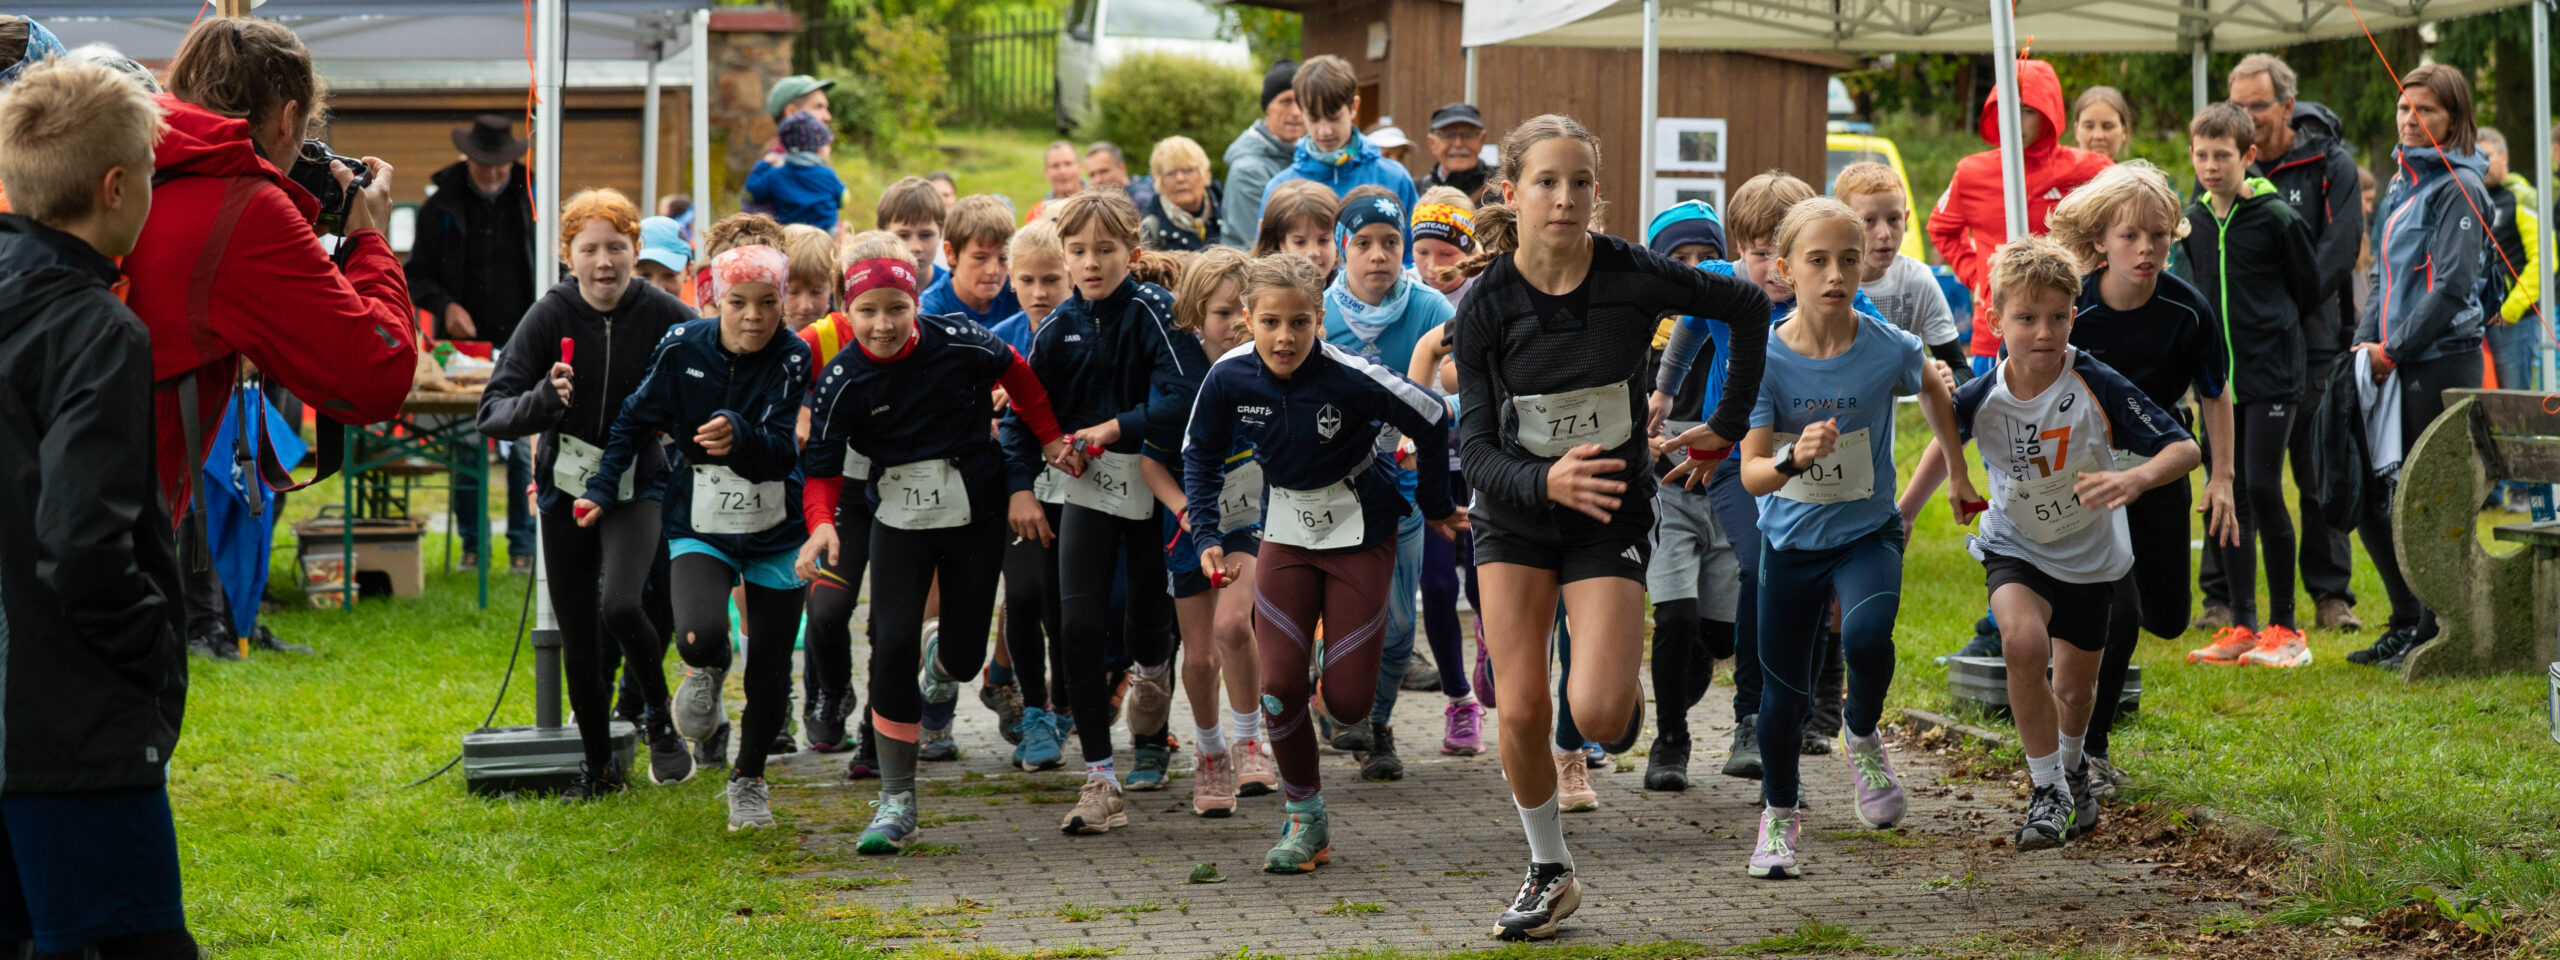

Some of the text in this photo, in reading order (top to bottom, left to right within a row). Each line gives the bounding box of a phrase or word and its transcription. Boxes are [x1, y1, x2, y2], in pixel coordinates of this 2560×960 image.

[1064, 334, 1081, 342] JAKO
[686, 367, 704, 378] JAKO
[1237, 405, 1265, 415] CRAFT
[1794, 397, 1857, 409] POWER
[1547, 411, 1599, 437] 77-1
[2014, 437, 2029, 469] LAUF
[1093, 470, 1127, 496] 42-1
[719, 491, 761, 510] 72-1
[903, 487, 940, 506] 71-1
[2035, 492, 2081, 521] 51-1
